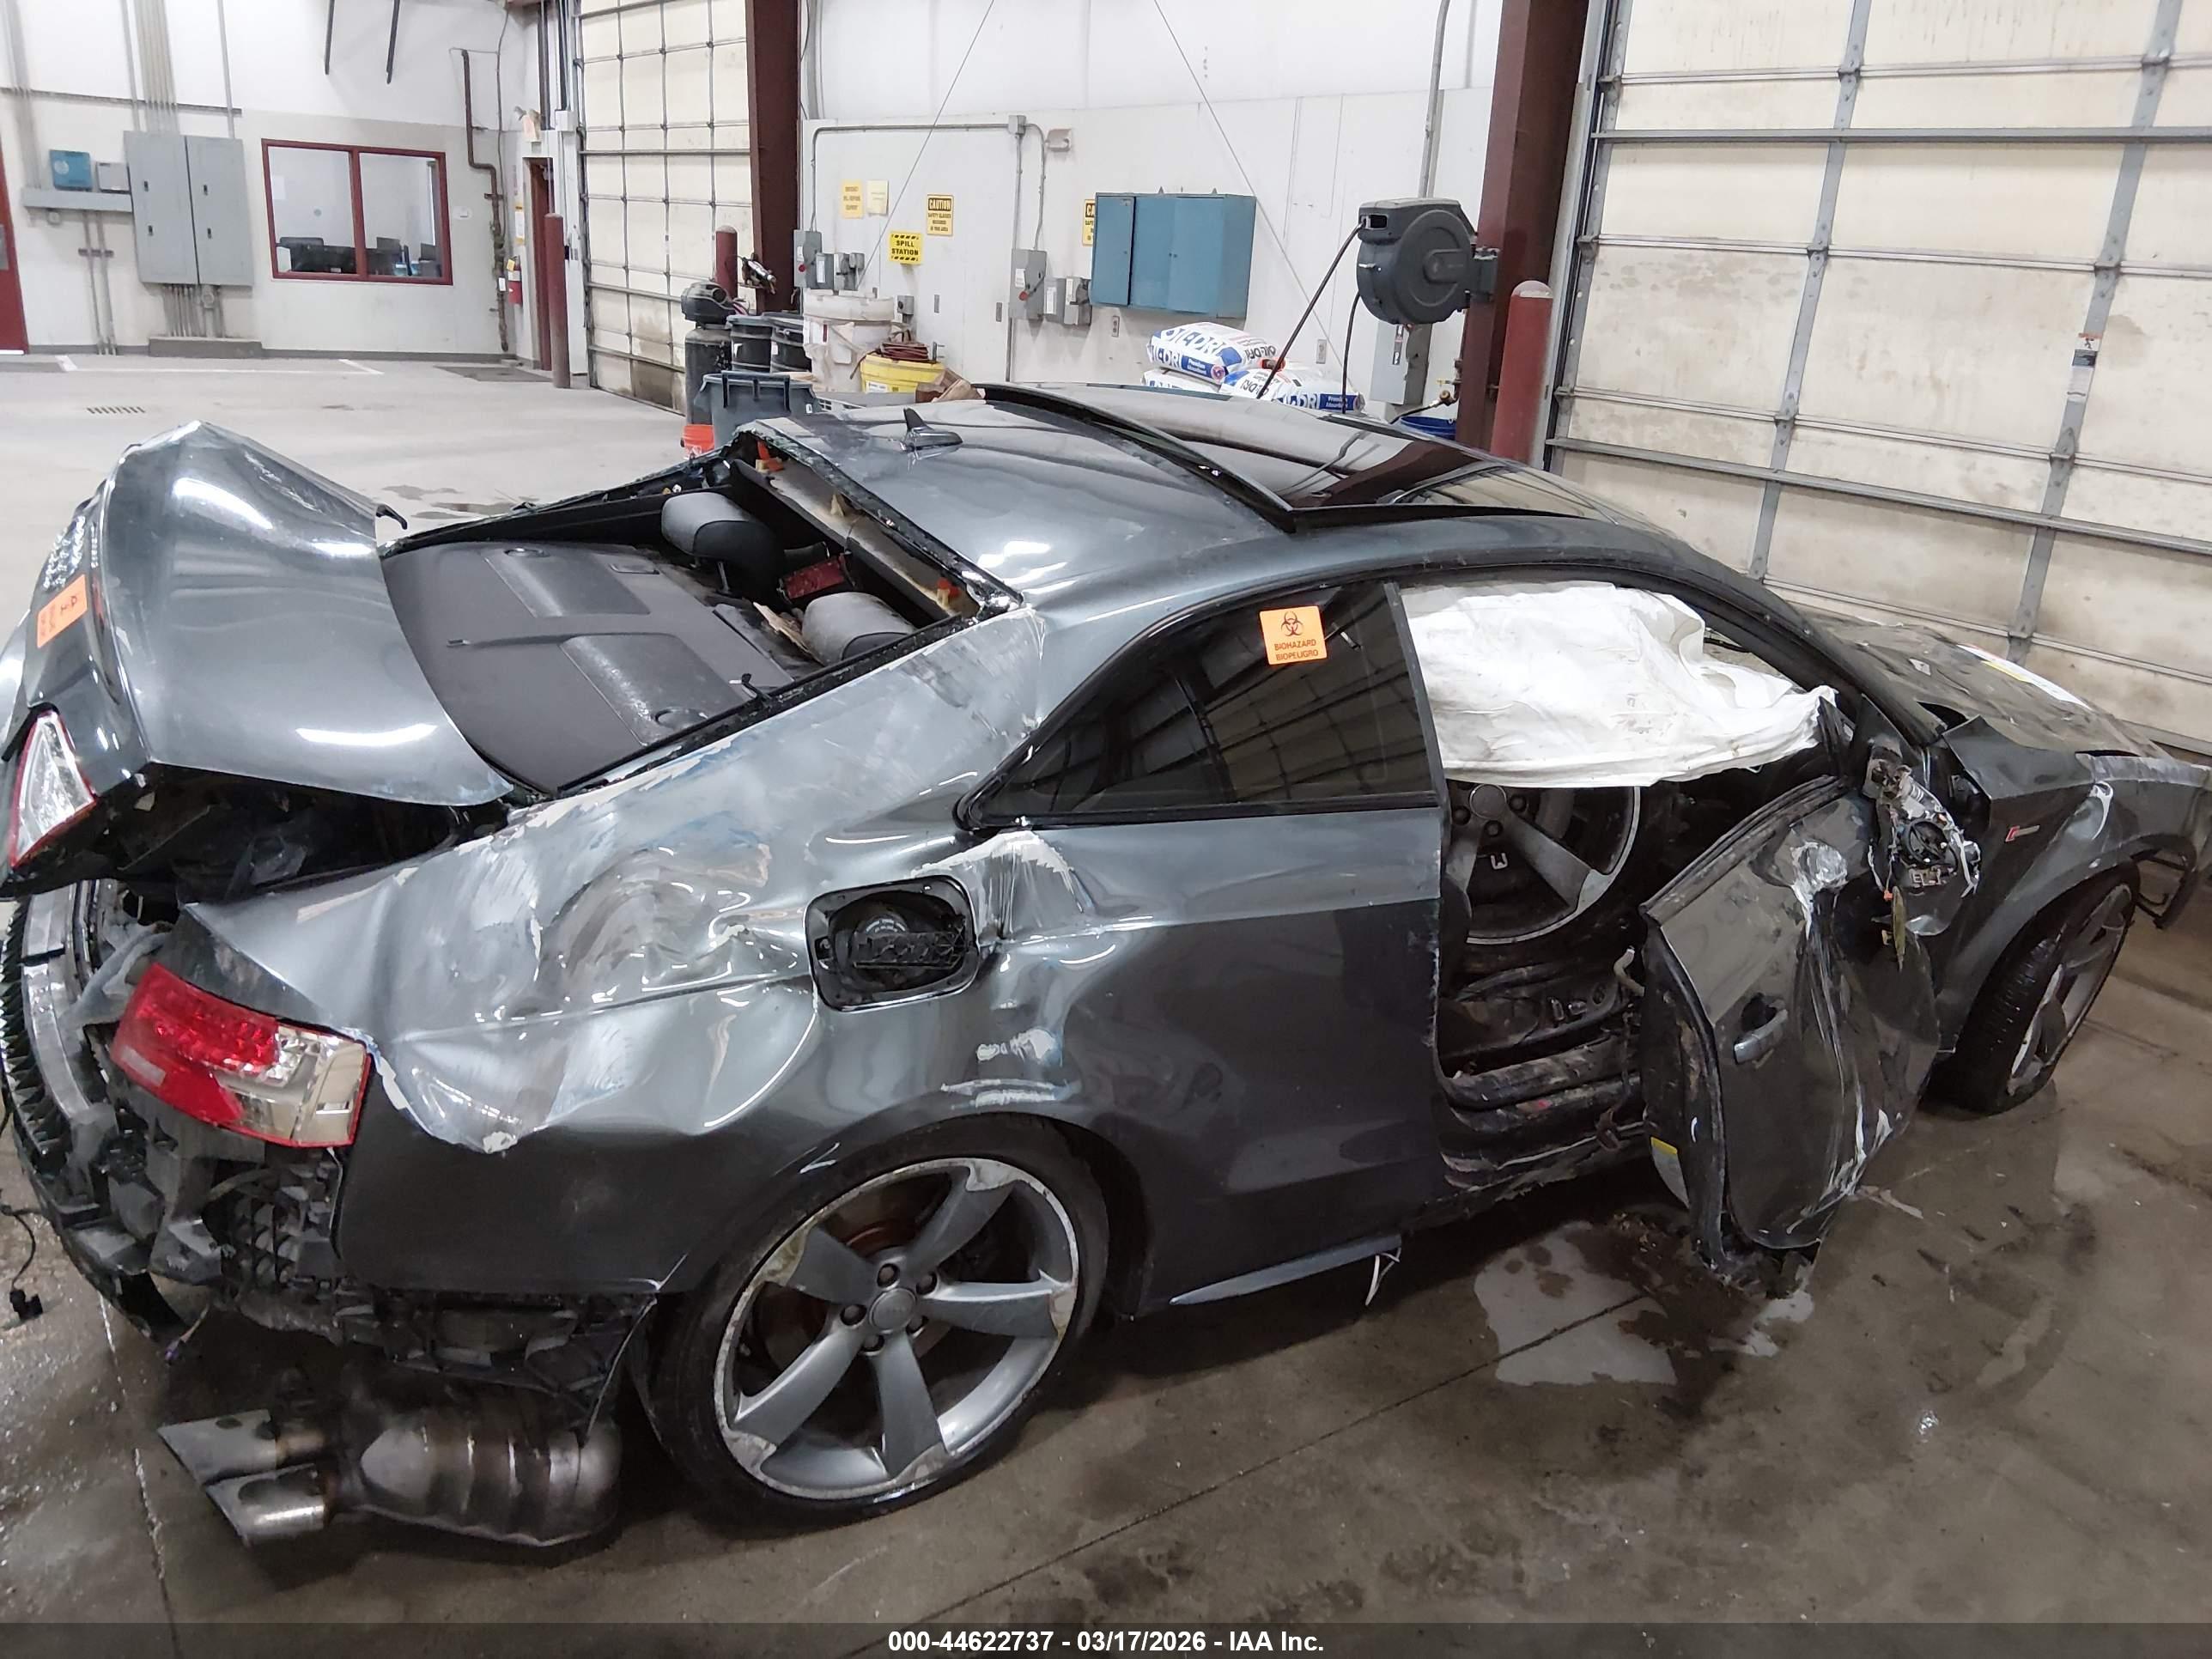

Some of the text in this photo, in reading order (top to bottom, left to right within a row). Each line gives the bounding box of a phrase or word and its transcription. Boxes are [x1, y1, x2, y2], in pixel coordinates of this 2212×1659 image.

[929, 198, 951, 210] CAUTION
[891, 247, 919, 256] STATION
[1273, 639, 1316, 651] BIOHAZARD
